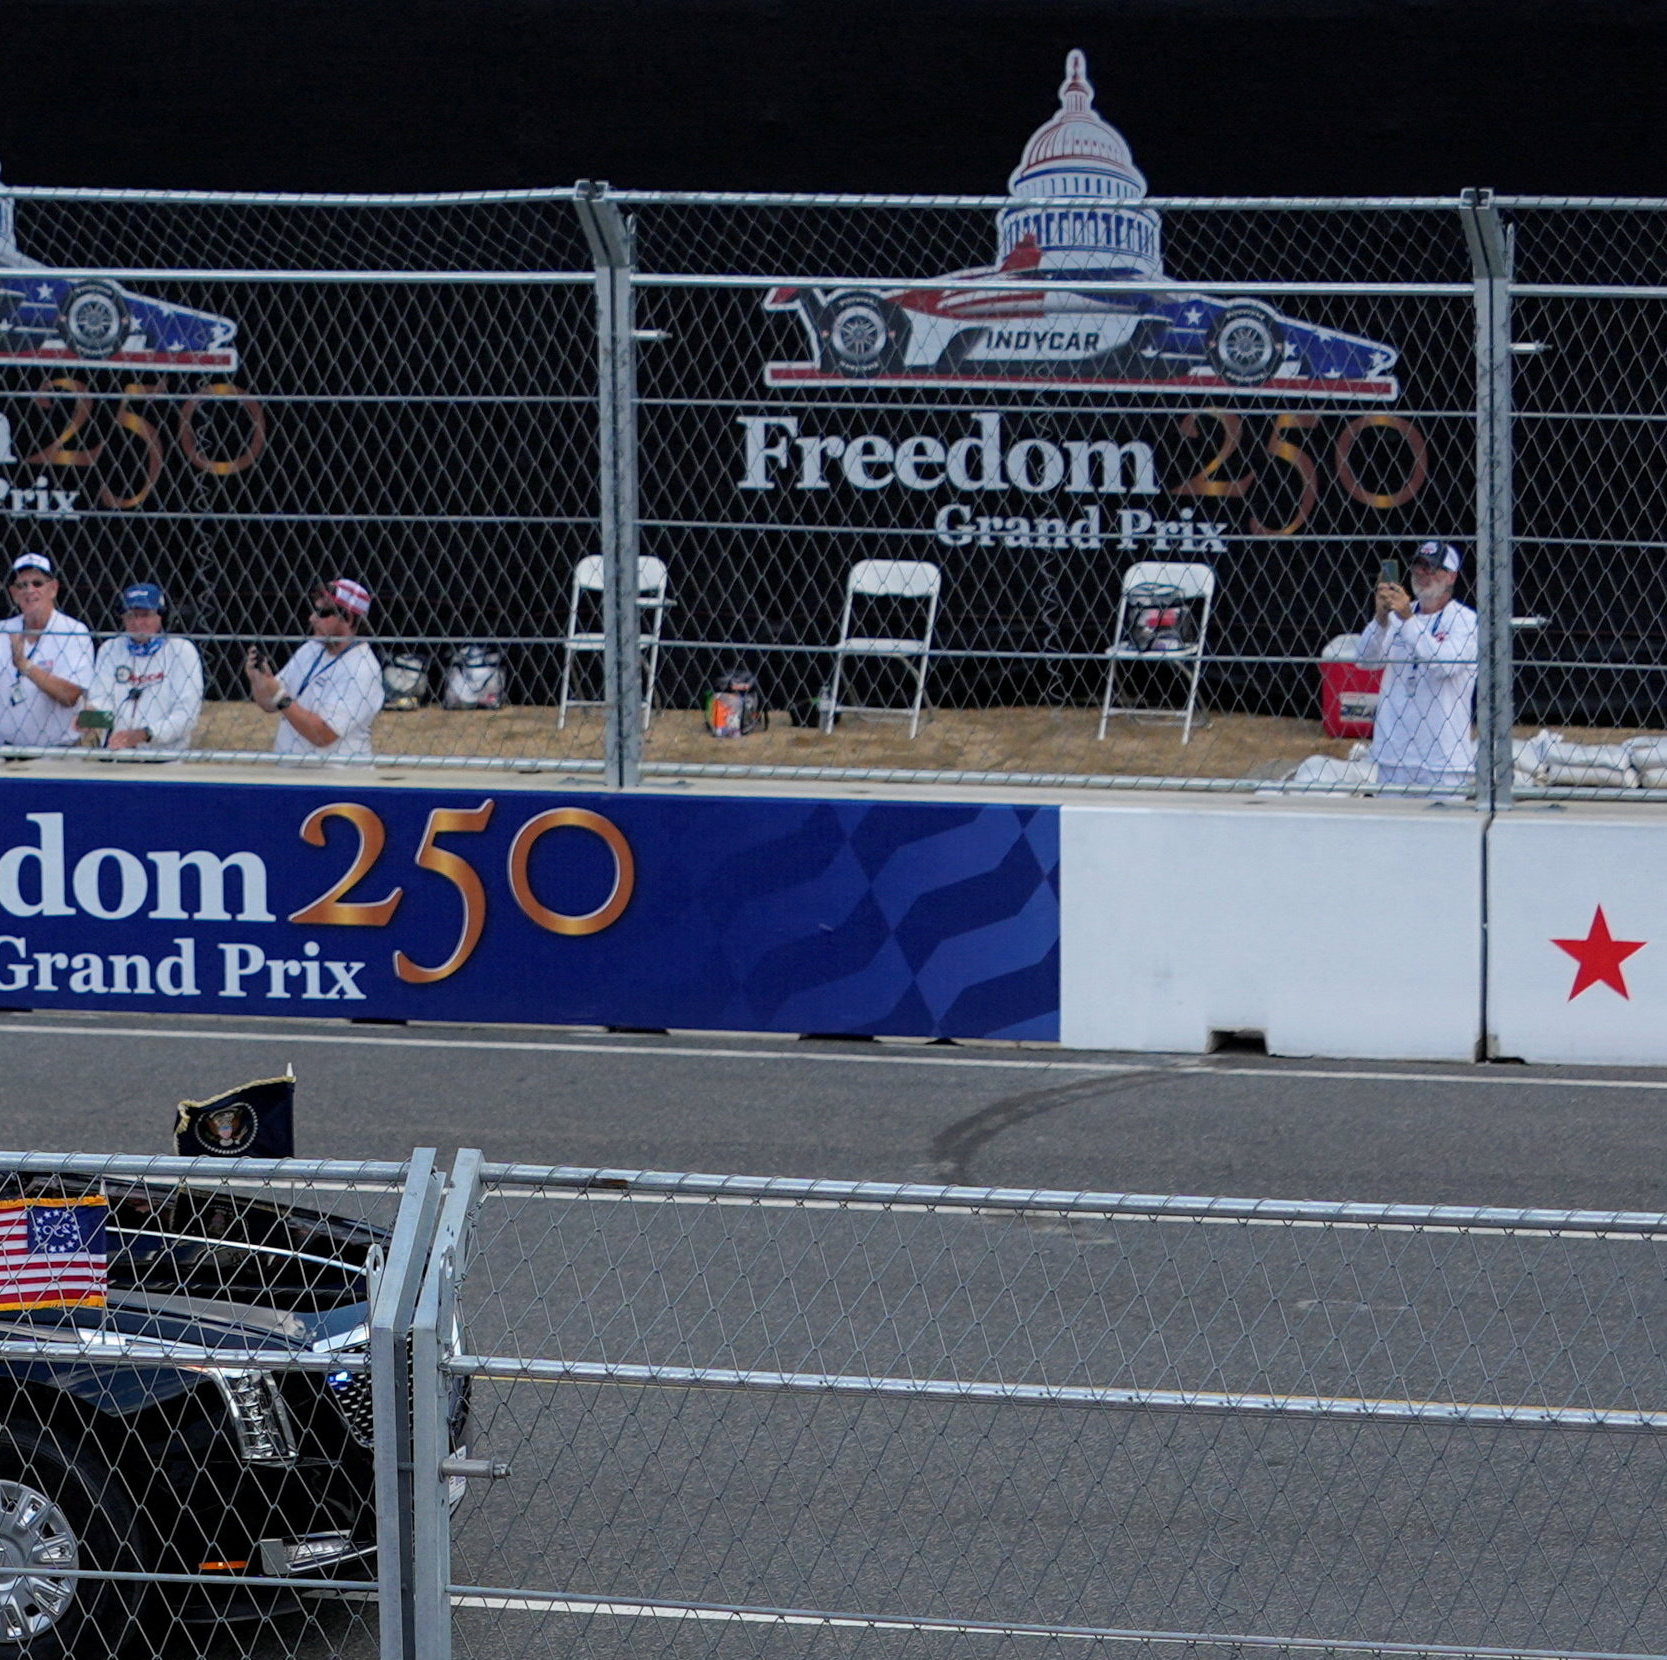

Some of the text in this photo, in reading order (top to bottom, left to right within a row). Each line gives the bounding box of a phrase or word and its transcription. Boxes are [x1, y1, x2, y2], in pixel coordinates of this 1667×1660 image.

[986, 330, 1100, 352] INDYCAR
[24, 372, 267, 508] 250
[736, 406, 1429, 537] Freedom 250
[934, 503, 1228, 553] Grand Prix
[288, 796, 637, 986] 250
[217, 941, 368, 1002] Prix
